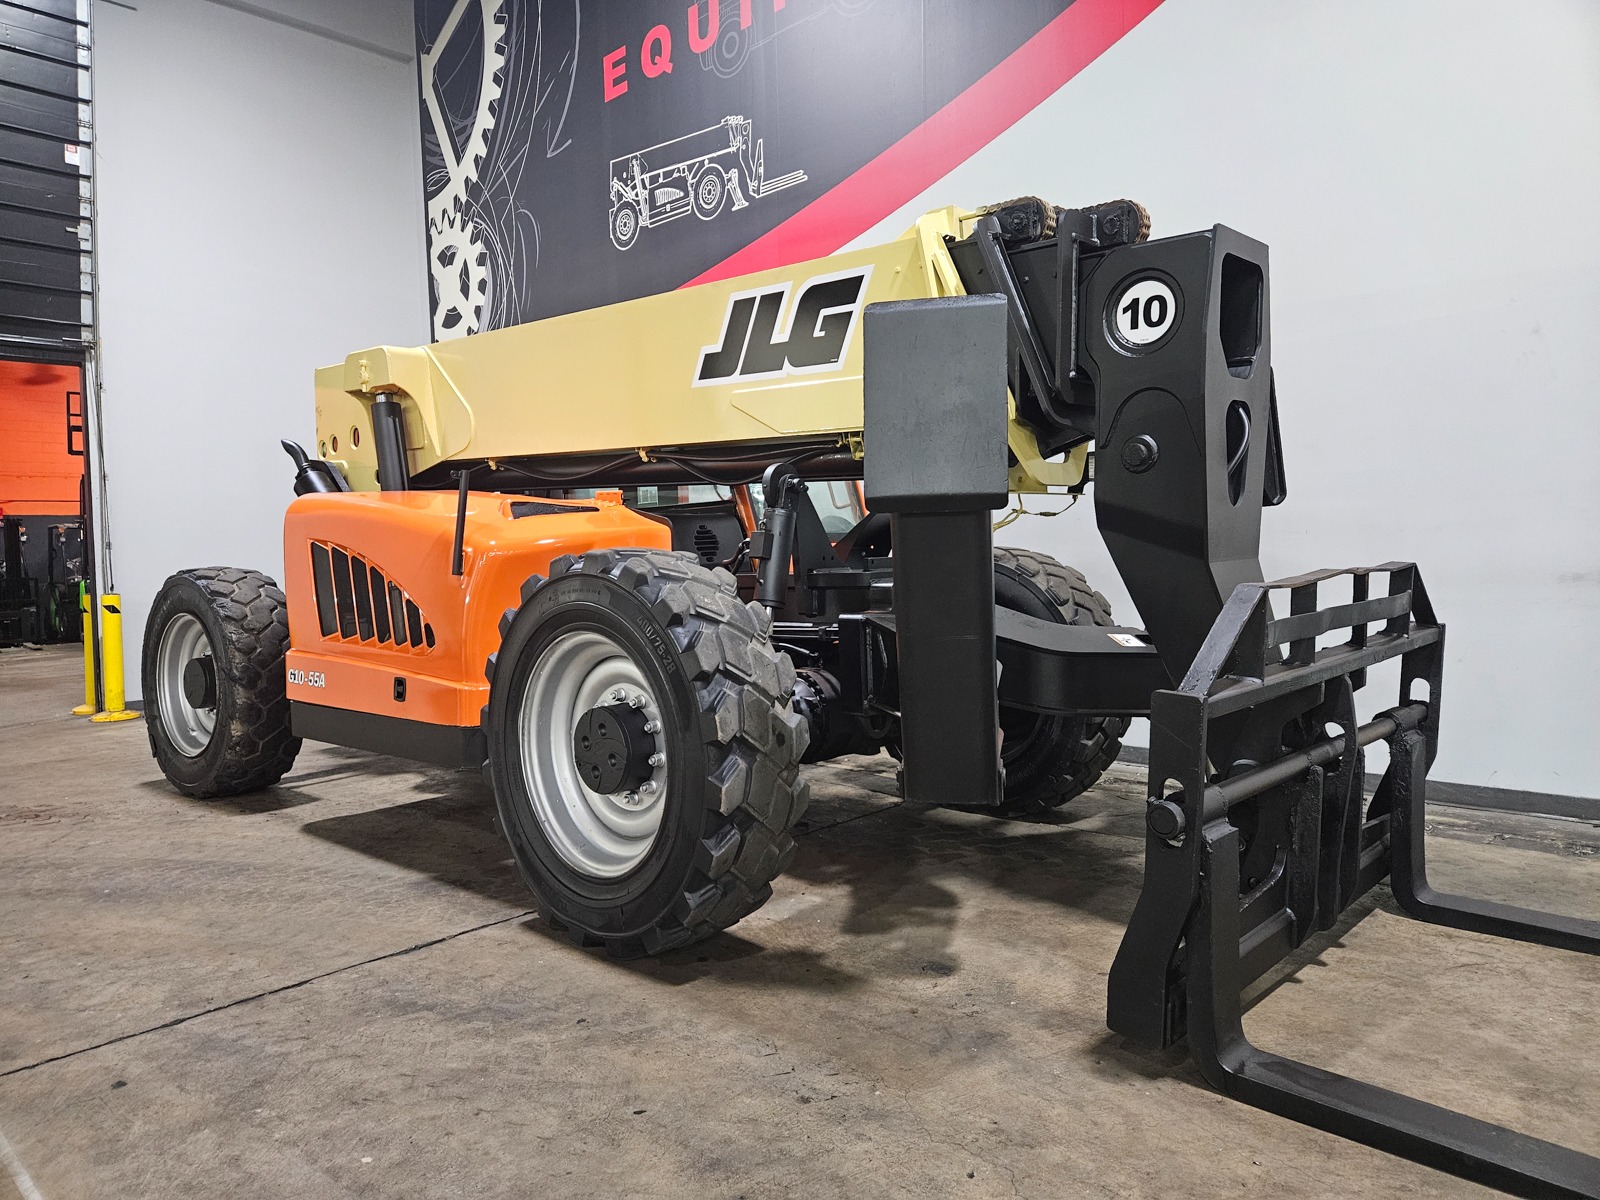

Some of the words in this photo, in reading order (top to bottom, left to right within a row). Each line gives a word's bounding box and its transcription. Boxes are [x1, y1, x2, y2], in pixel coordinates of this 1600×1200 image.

[603, 0, 786, 103] EQUI
[697, 274, 866, 380] JLG
[1122, 294, 1168, 330] 10
[288, 668, 325, 688] G10-55A
